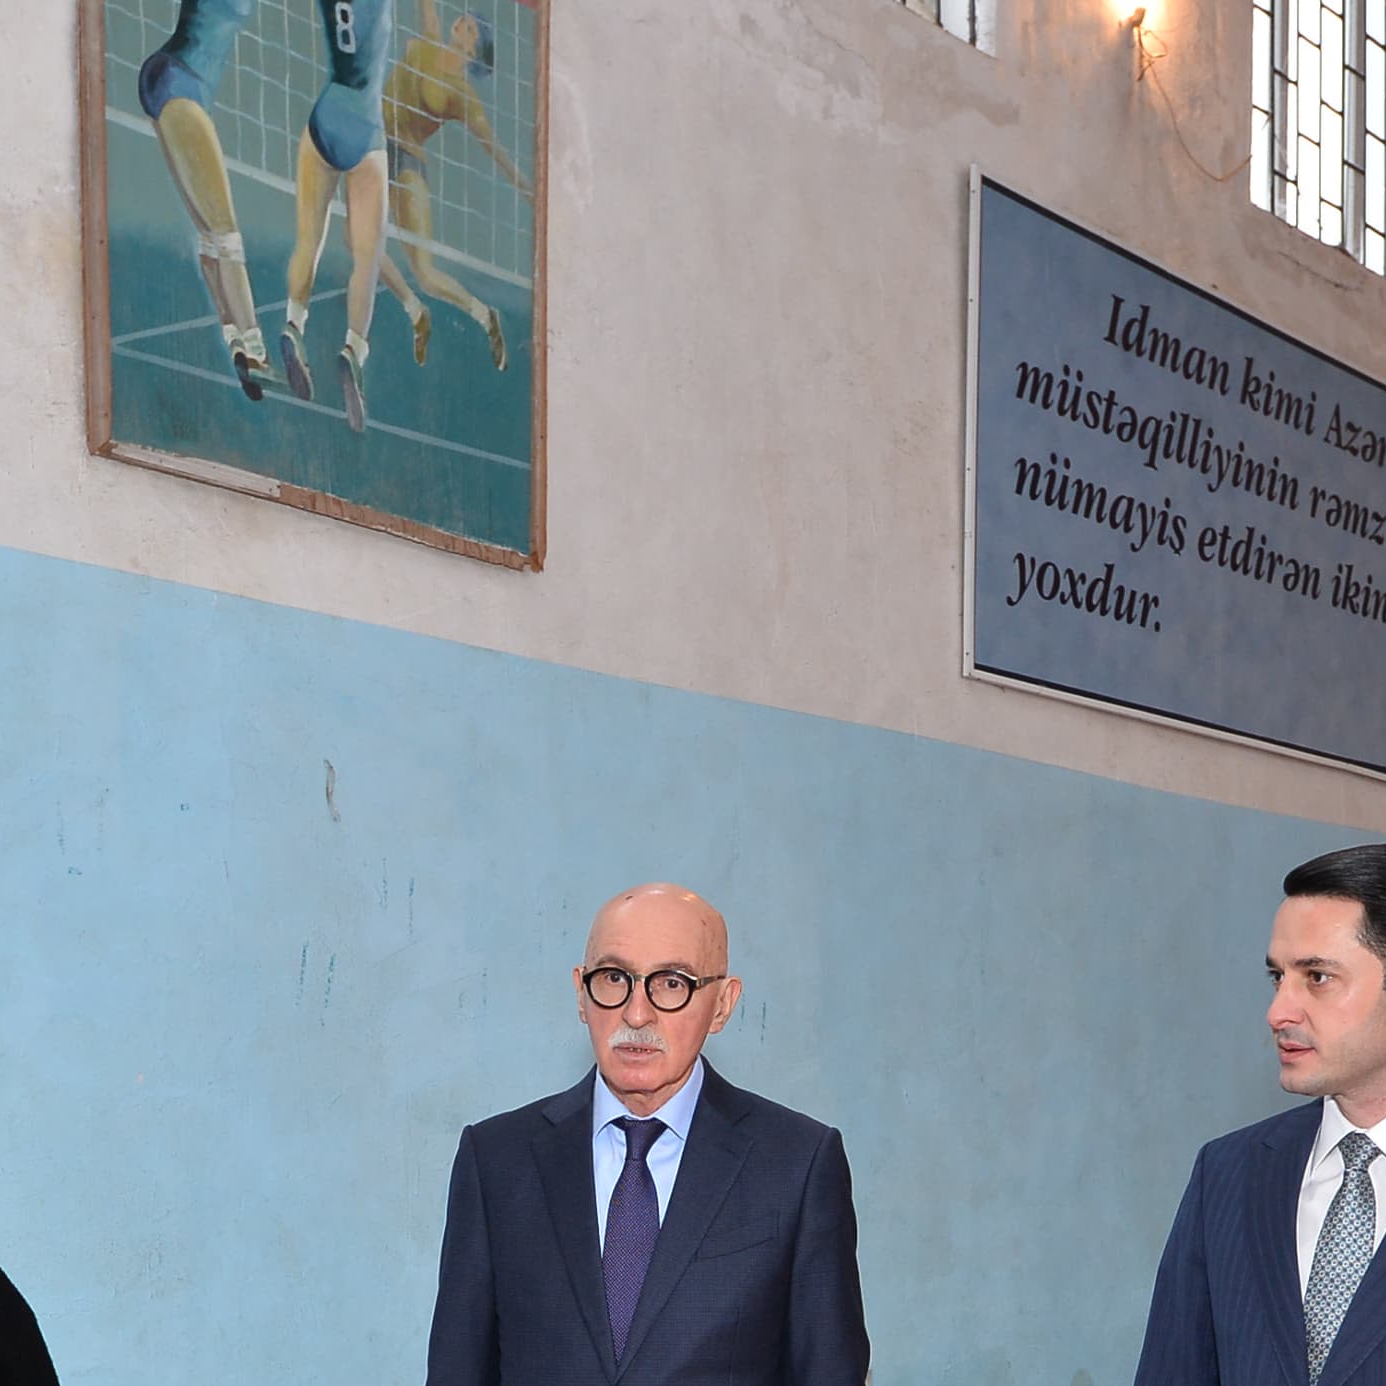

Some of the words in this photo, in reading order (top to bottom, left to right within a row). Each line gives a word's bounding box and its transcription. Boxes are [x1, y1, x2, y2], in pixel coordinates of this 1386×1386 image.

[335, 2, 356, 54] 8
[1103, 294, 1229, 397] Idman
[1240, 357, 1316, 435] kimi
[1015, 361, 1299, 510] müstəqilliyinin
[1006, 553, 1161, 632] yoxdur.
[1014, 452, 1186, 556] nümayiş
[1198, 523, 1320, 600] etdirən
